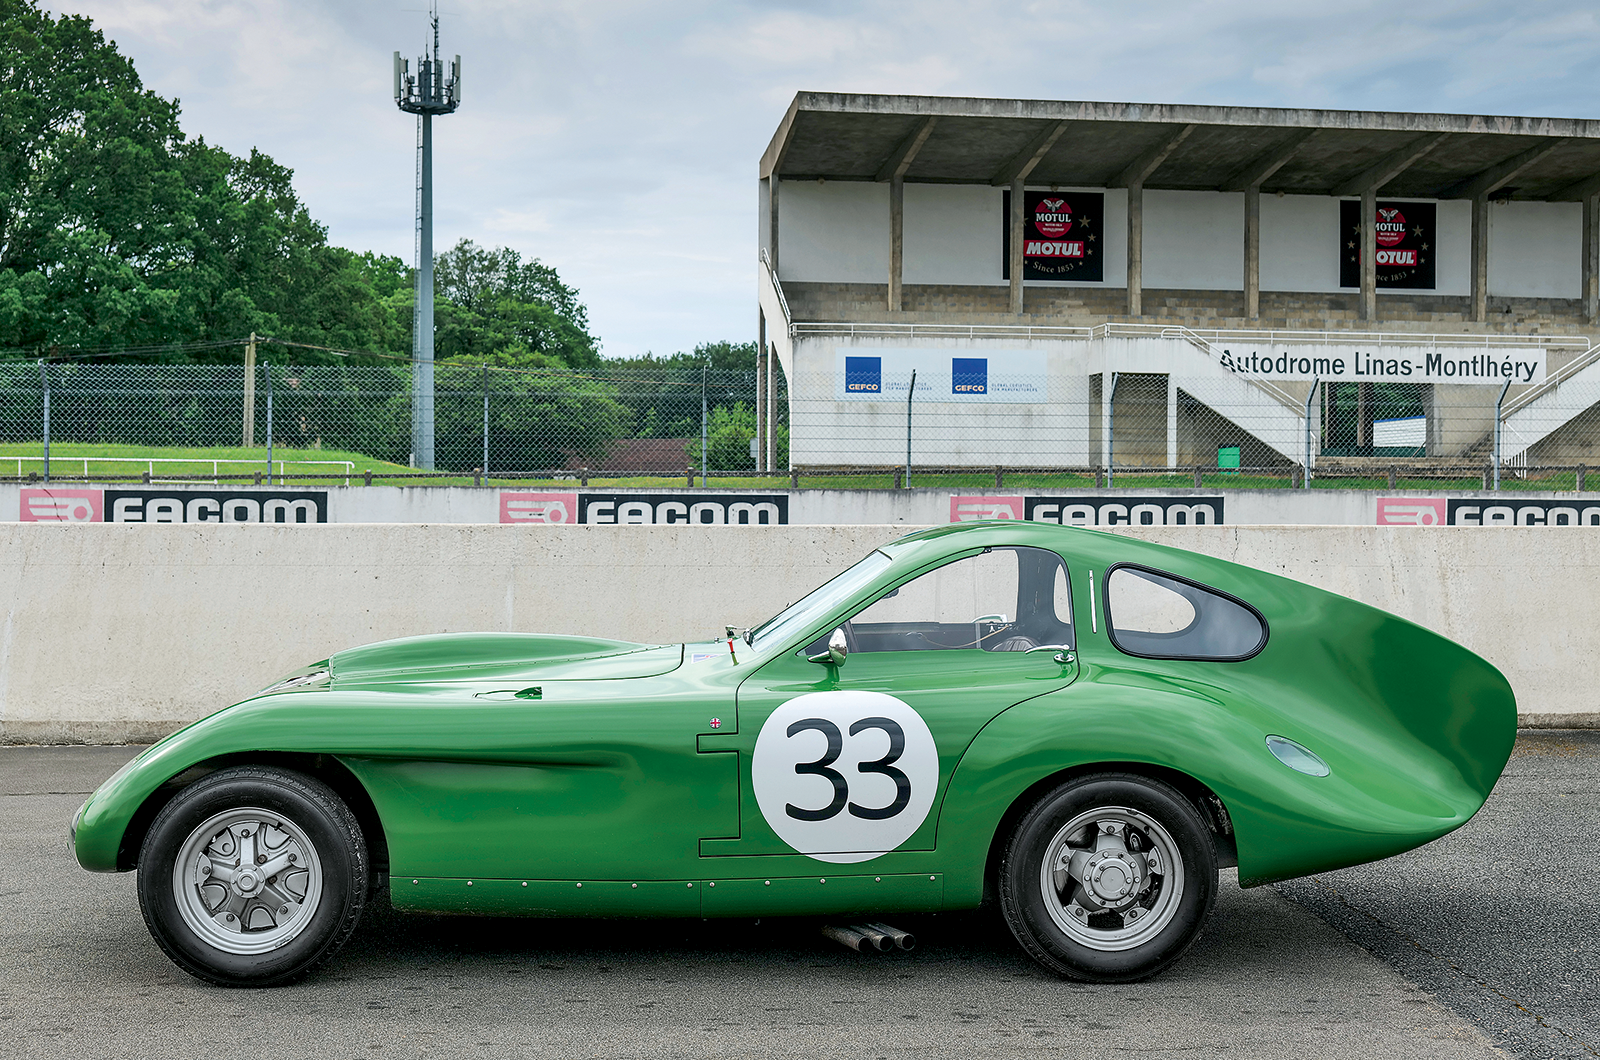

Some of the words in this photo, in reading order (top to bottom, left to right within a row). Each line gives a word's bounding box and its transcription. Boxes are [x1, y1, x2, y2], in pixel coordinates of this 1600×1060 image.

[1036, 213, 1071, 222] MOTUL
[1026, 242, 1081, 256] MOTUL
[1376, 250, 1414, 264] OTUL
[1032, 260, 1054, 274] Since
[1058, 262, 1074, 273] 1853
[1220, 350, 1345, 374] Autodrome
[1355, 352, 1538, 382] Linas-Montlhéry
[113, 497, 318, 523] FACOM
[586, 501, 779, 524] FACOM
[786, 717, 911, 821] 33
